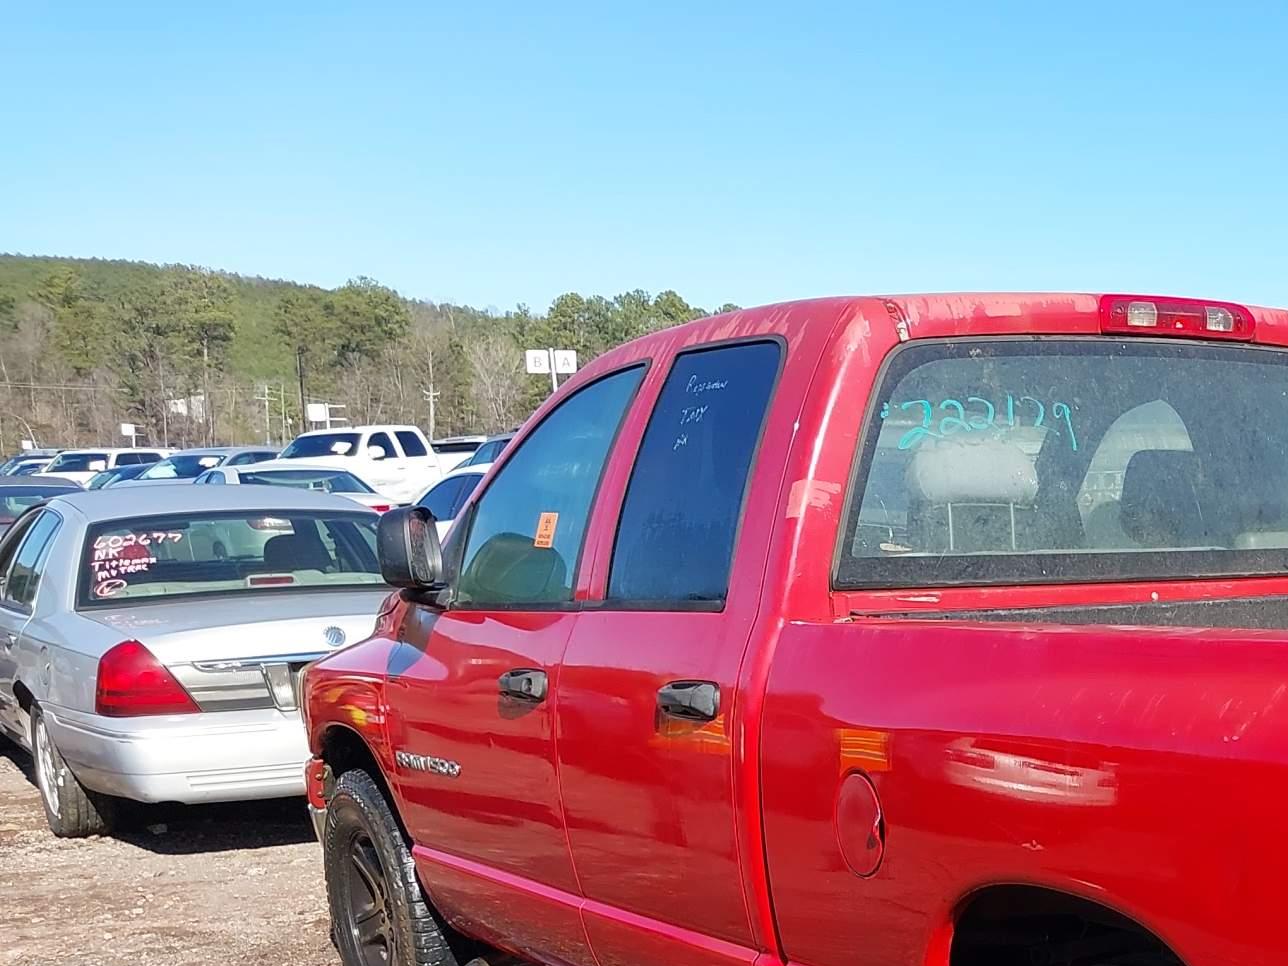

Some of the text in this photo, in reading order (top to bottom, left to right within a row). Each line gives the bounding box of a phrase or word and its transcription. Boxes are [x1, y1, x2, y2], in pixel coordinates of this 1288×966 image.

[533, 356, 542, 368] B
[562, 356, 570, 368] A
[93, 533, 182, 549] 602677
